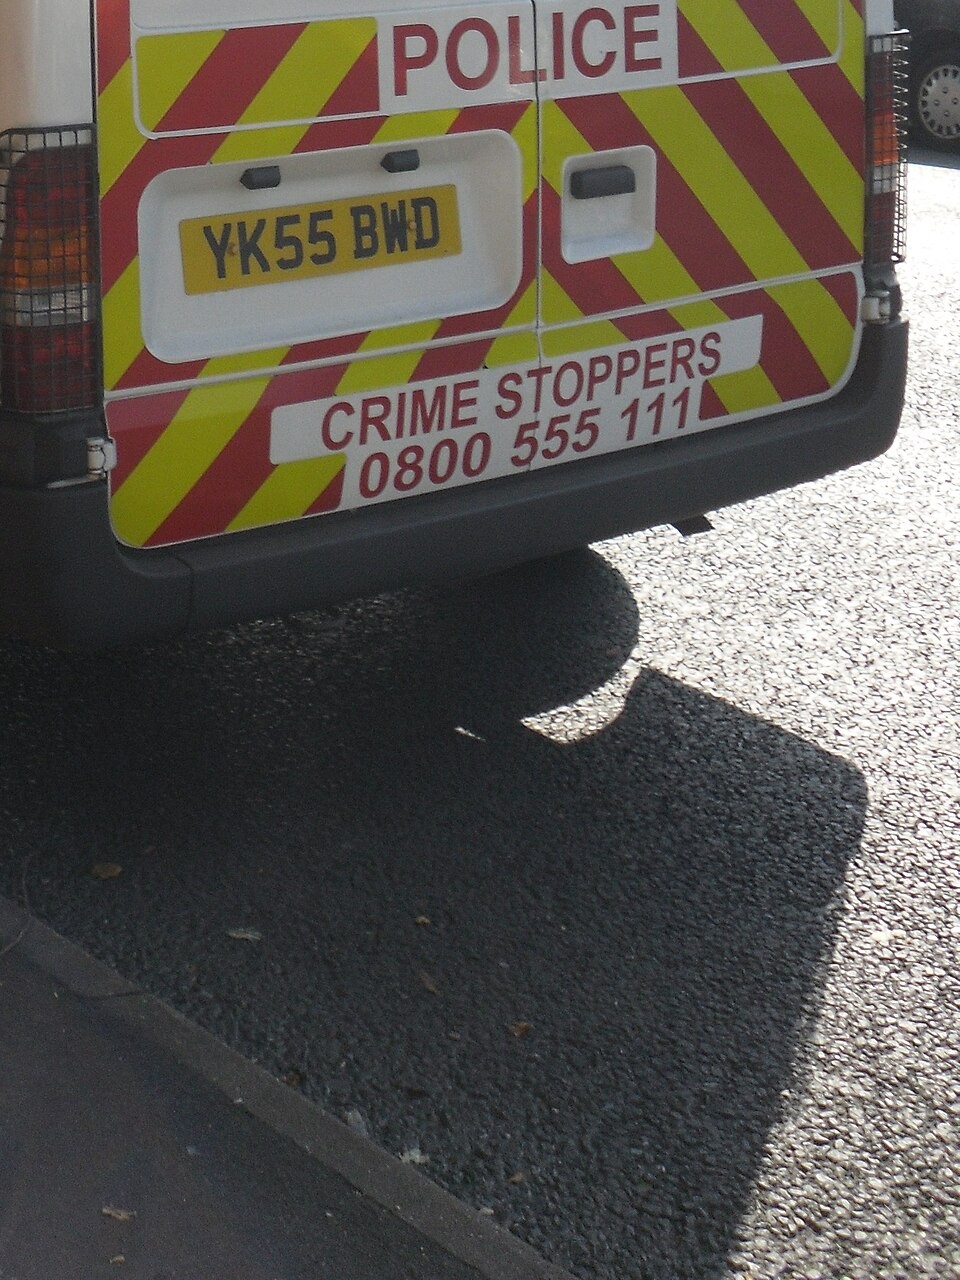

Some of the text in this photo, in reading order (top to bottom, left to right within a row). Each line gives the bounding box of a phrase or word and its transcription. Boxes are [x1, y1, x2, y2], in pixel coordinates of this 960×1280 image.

[392, 4, 662, 97] POLICE
[203, 196, 440, 278] YK55 BWD
[321, 332, 722, 451] CRIME STOPPERS
[358, 387, 691, 498] 0800 555 111
